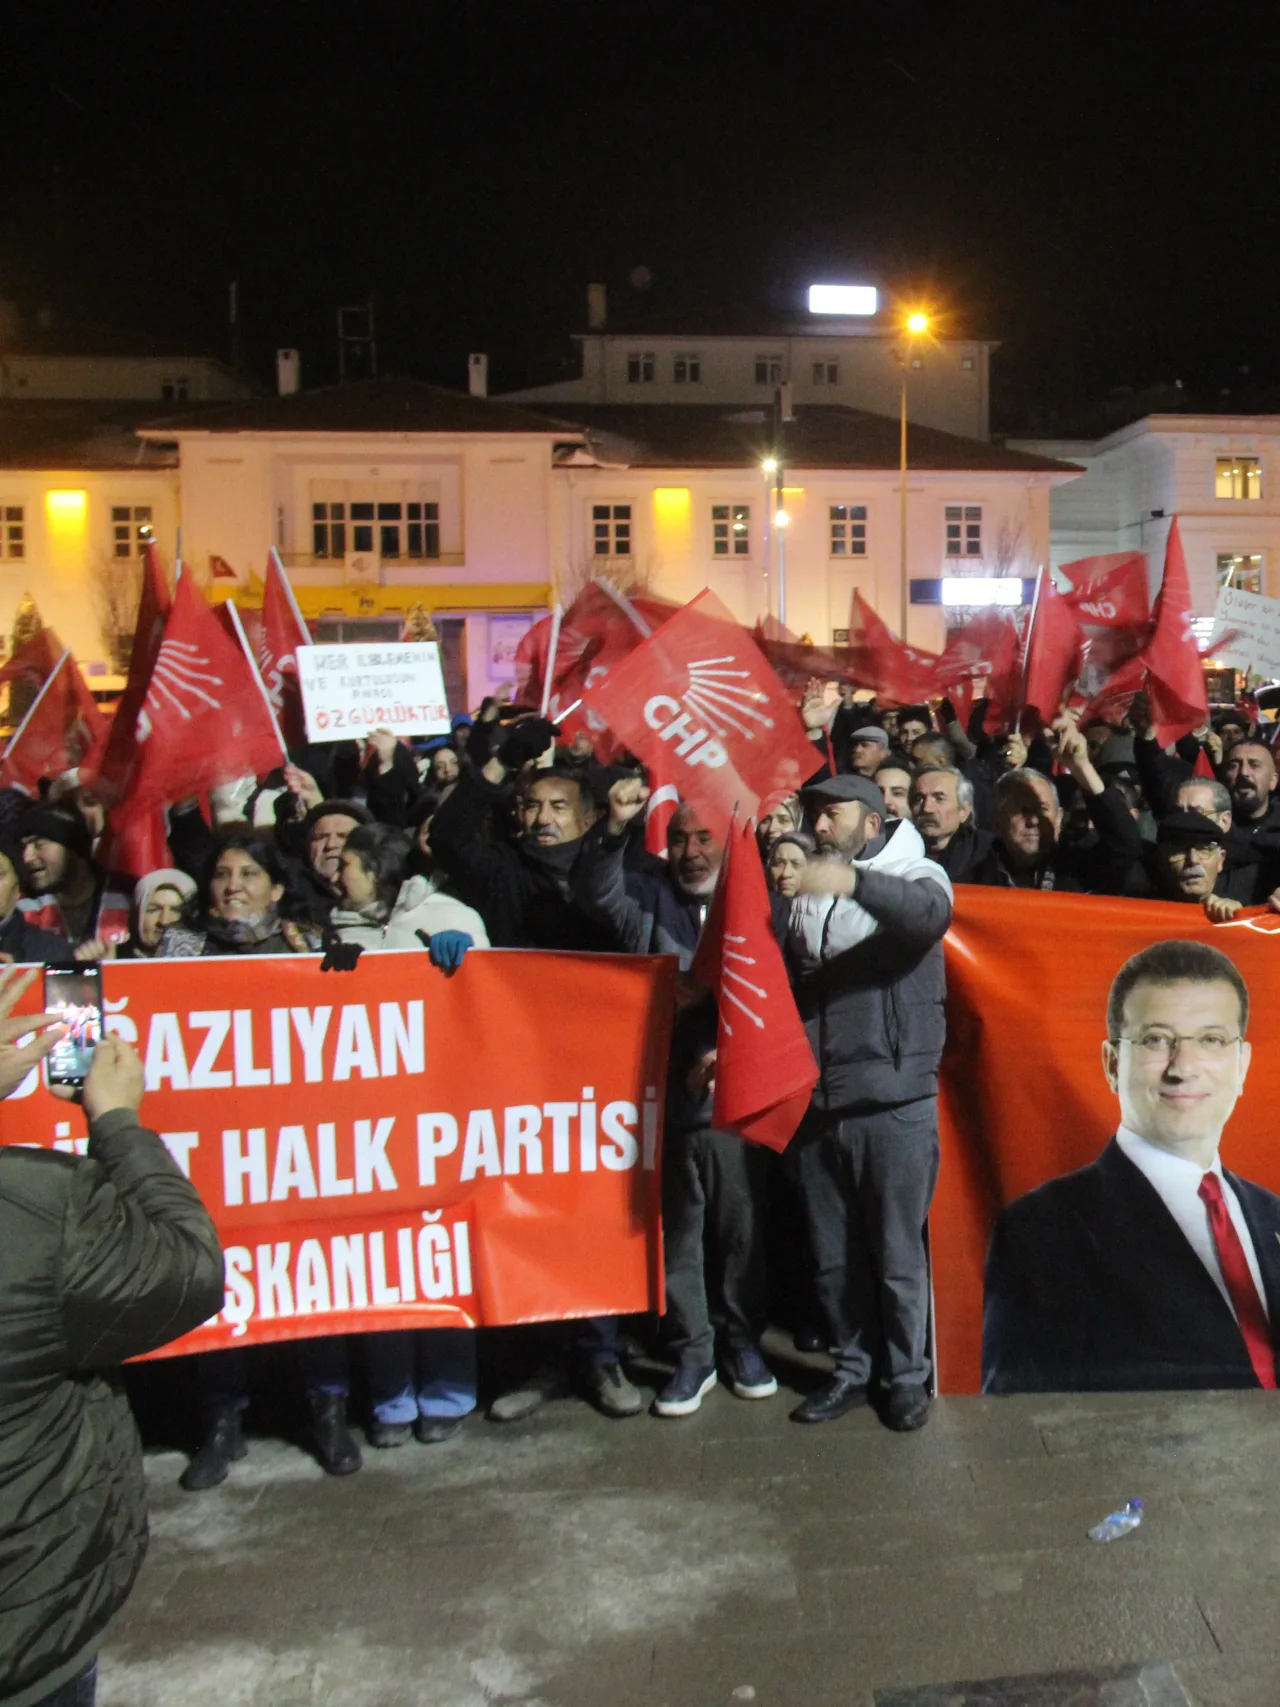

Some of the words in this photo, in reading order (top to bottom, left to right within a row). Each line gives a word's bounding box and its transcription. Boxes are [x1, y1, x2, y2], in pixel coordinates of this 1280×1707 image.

[644, 695, 728, 769] CHP
[223, 1117, 398, 1206] HALK
[417, 1086, 657, 1187] PARTİSİ
[201, 1209, 473, 1336] ŞKANLIĞI
